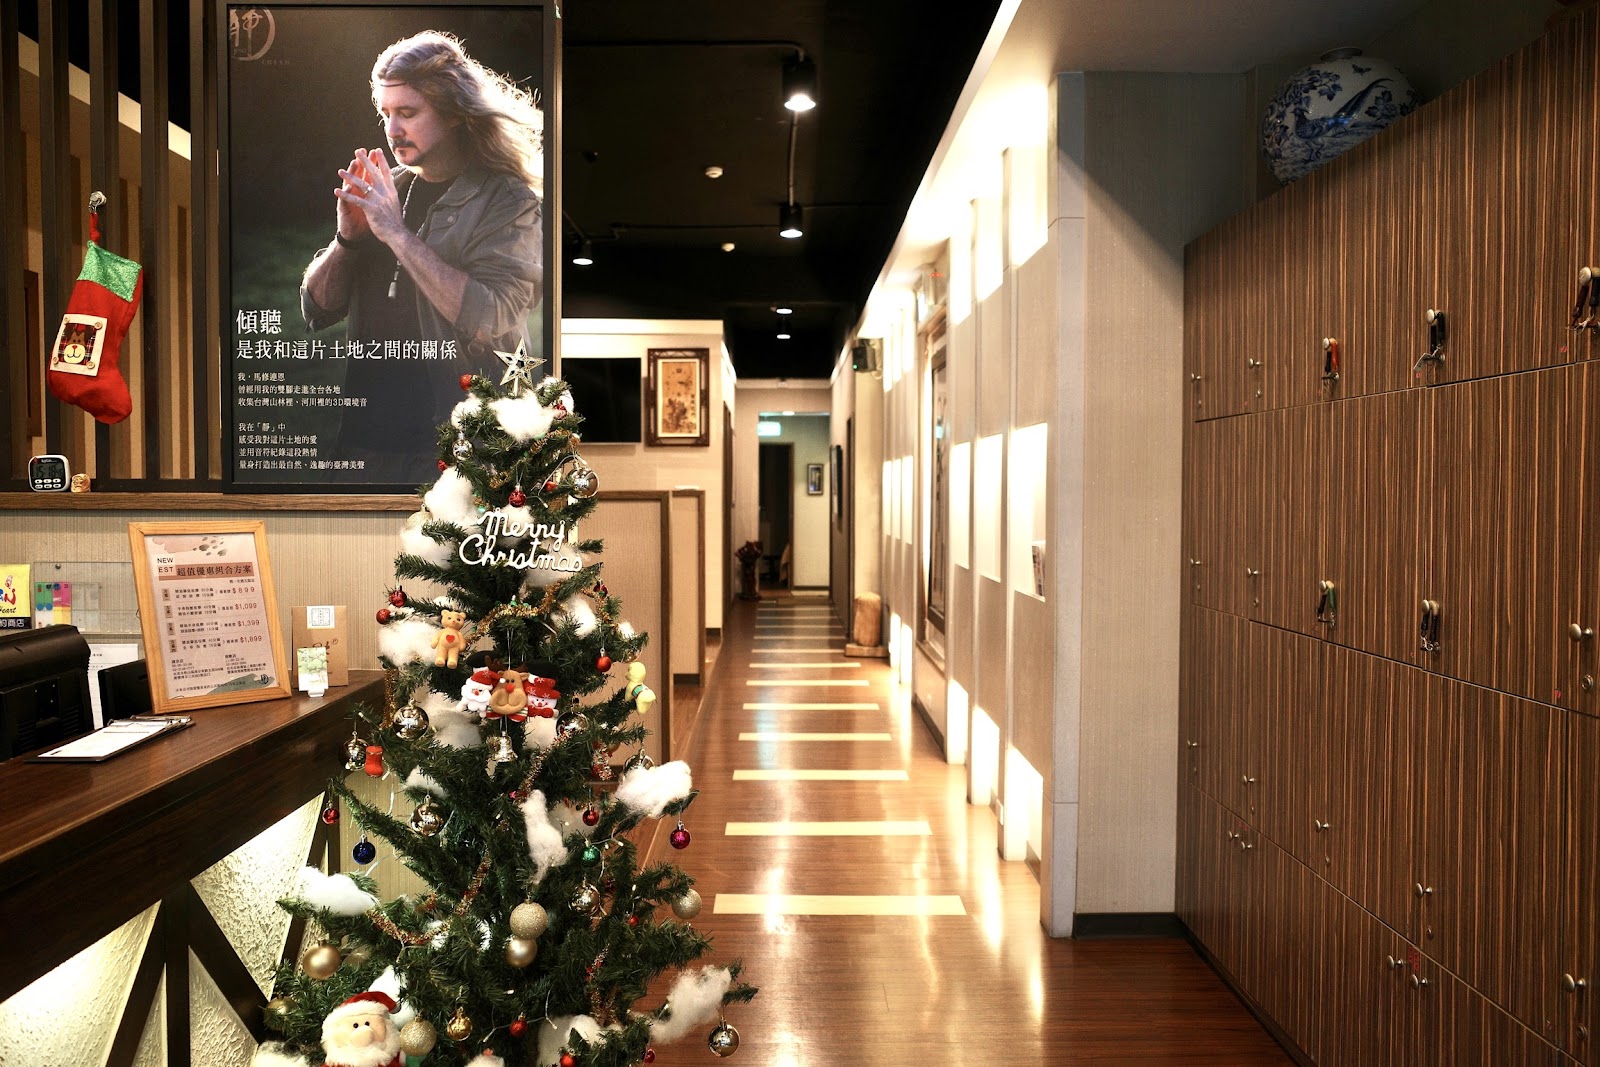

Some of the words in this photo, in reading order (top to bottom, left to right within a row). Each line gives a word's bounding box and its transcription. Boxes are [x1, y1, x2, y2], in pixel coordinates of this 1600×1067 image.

[236, 309, 282, 335] 傾聽
[236, 339, 457, 360] 是我和這片土地之間的關係
[477, 507, 565, 552] Merry
[459, 533, 583, 572] Christmas
[176, 565, 253, 577] 超值優惠組合方案
[235, 602, 257, 610] $1,099
